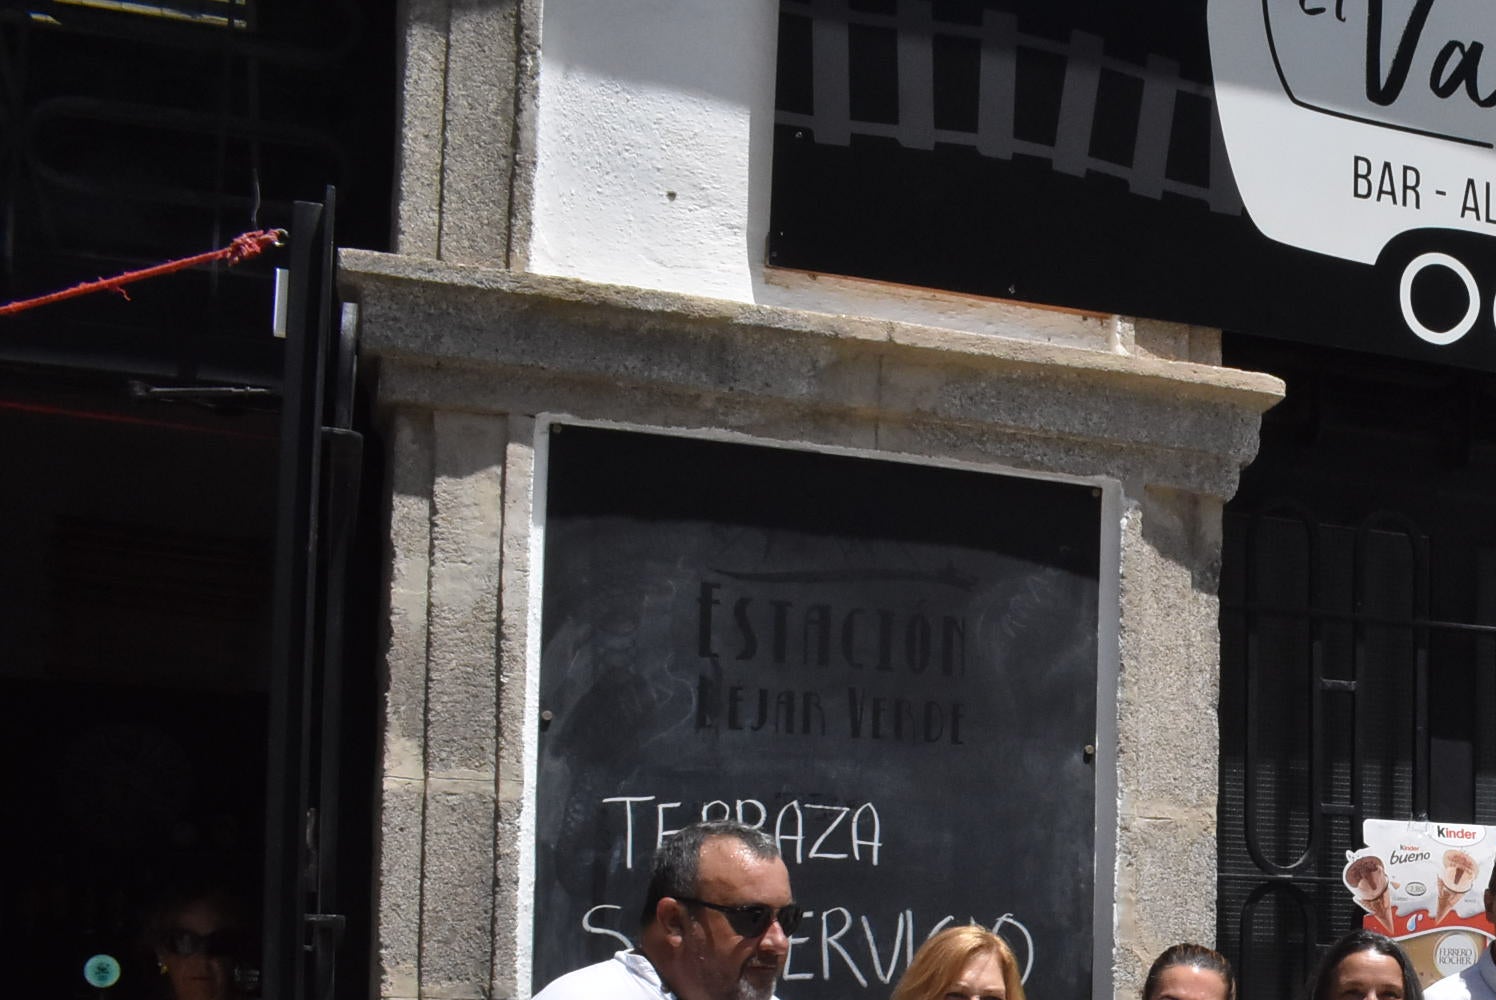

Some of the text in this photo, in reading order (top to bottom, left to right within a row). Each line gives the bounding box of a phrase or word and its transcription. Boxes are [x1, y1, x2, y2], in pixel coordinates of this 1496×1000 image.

[1353, 155, 1421, 210] BAR
[1390, 850, 1431, 865] bueno
[783, 905, 1034, 988] ERVIO
